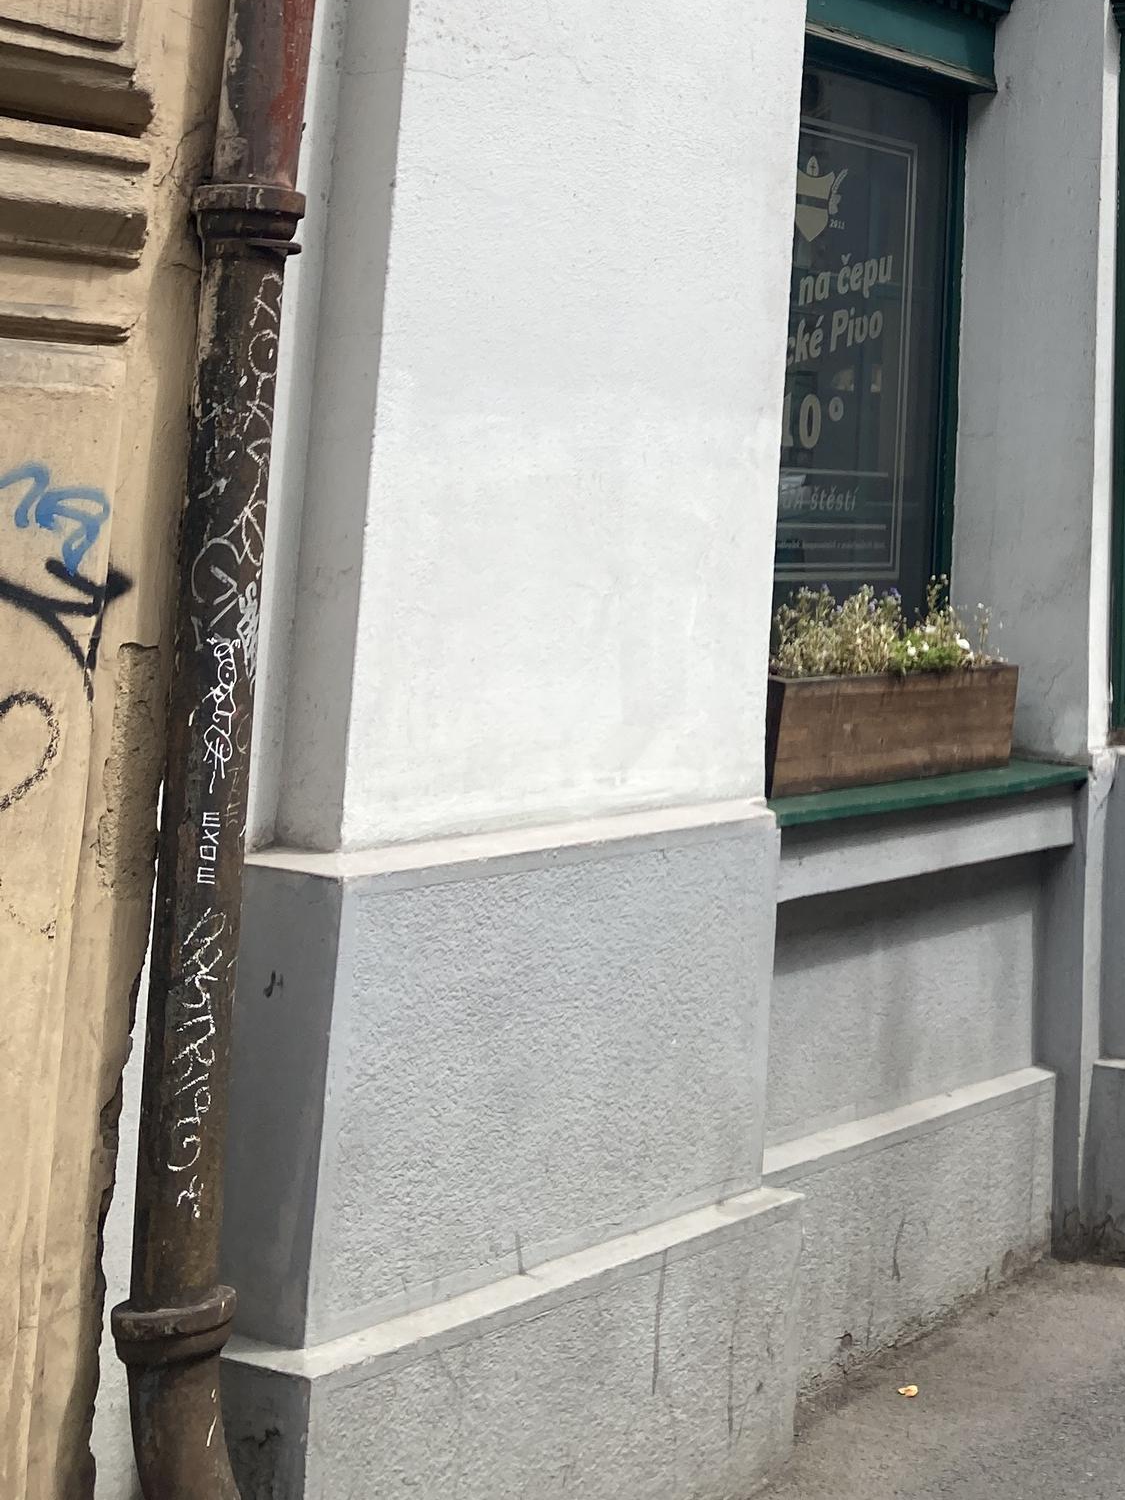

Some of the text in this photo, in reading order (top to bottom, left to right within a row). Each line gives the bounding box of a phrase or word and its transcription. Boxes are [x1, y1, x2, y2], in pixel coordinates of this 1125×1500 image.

[798, 253, 893, 306] na čepu
[830, 306, 883, 352] Pivo
